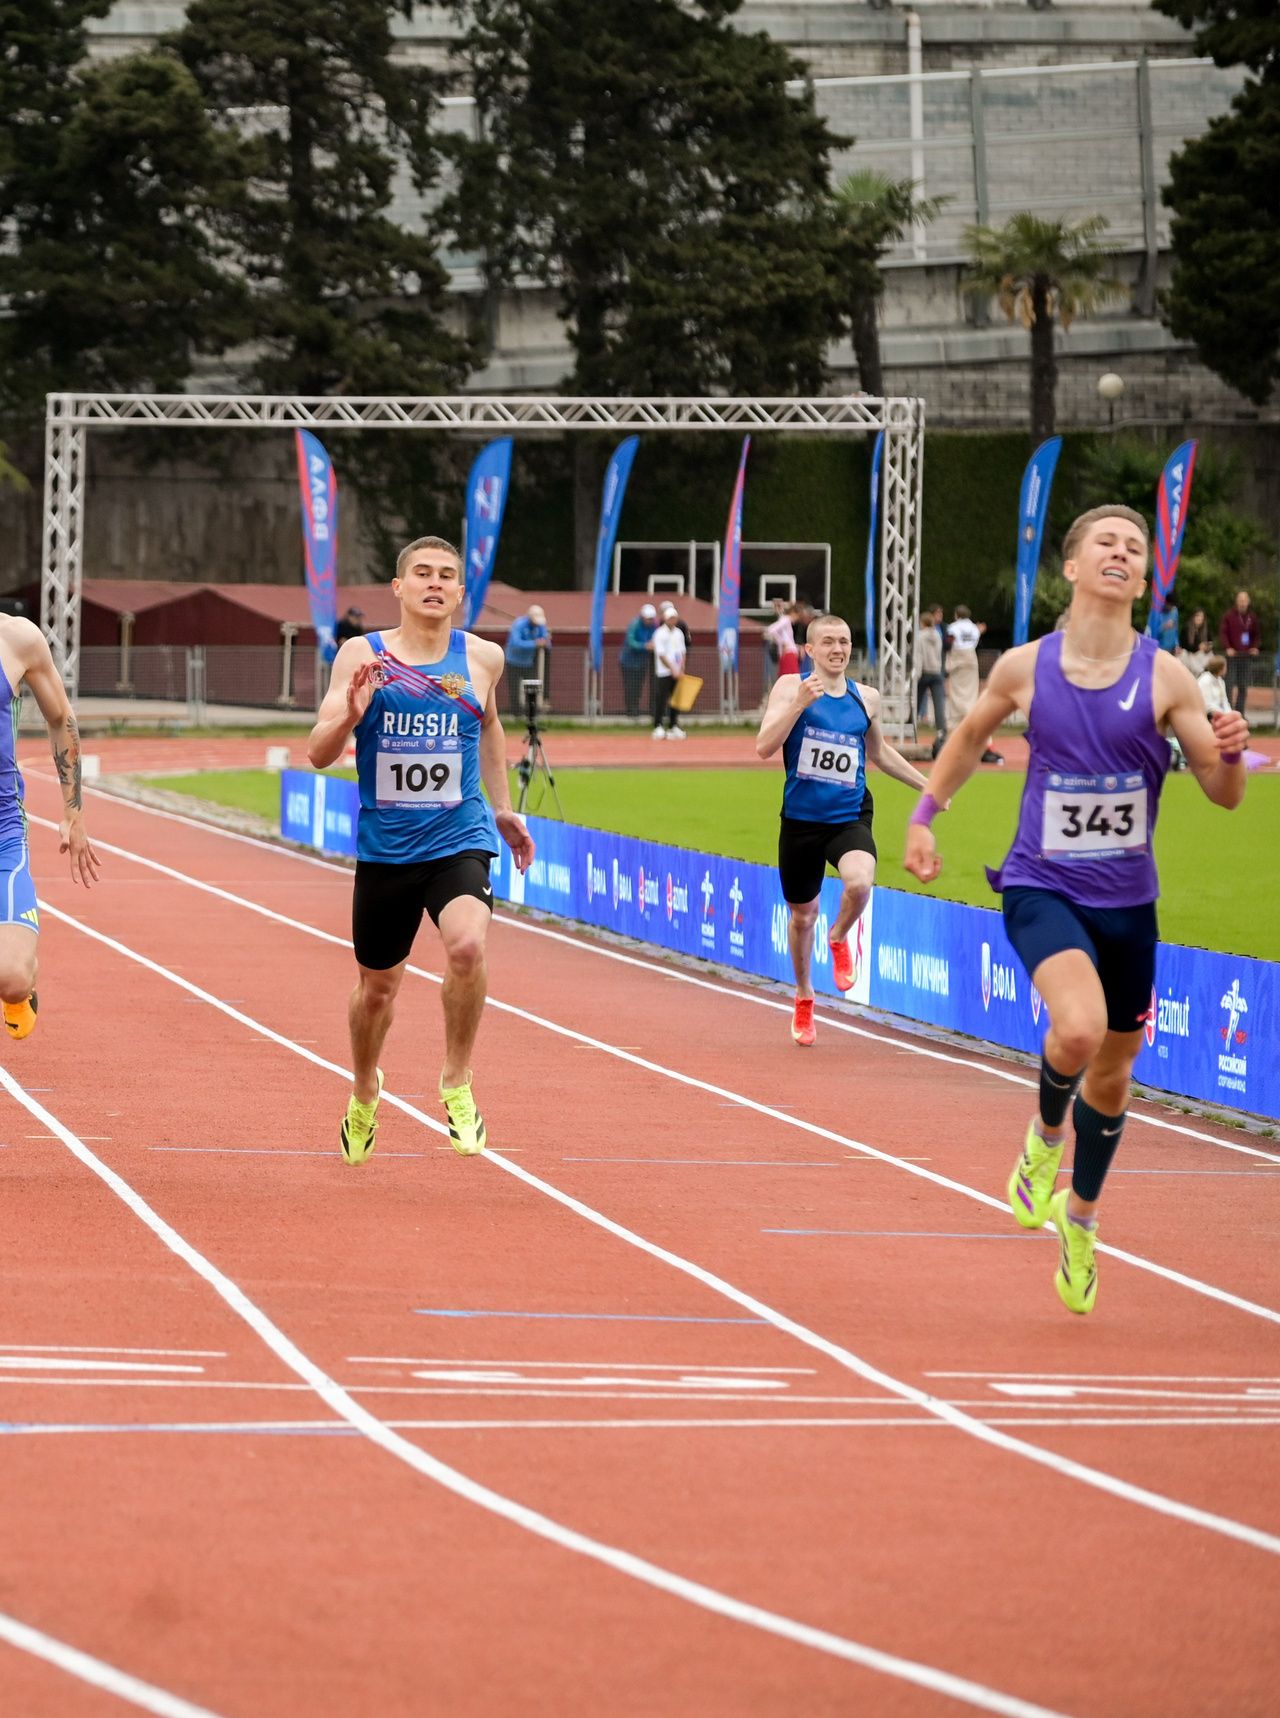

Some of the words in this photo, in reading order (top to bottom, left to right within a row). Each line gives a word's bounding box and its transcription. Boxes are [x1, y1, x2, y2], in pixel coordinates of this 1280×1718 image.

[383, 711, 459, 737] RUSSIA
[391, 740, 420, 748] azimut
[811, 748, 852, 773] 180
[390, 763, 451, 793] 109
[1064, 776, 1097, 787] azimut
[1061, 803, 1135, 838] 343
[771, 903, 788, 956] 400
[878, 942, 902, 984] ФИНАЛ
[912, 952, 949, 996] МУЖЧИНЫ
[992, 963, 1017, 1003] ВФЛА
[1158, 987, 1190, 1037] azimut
